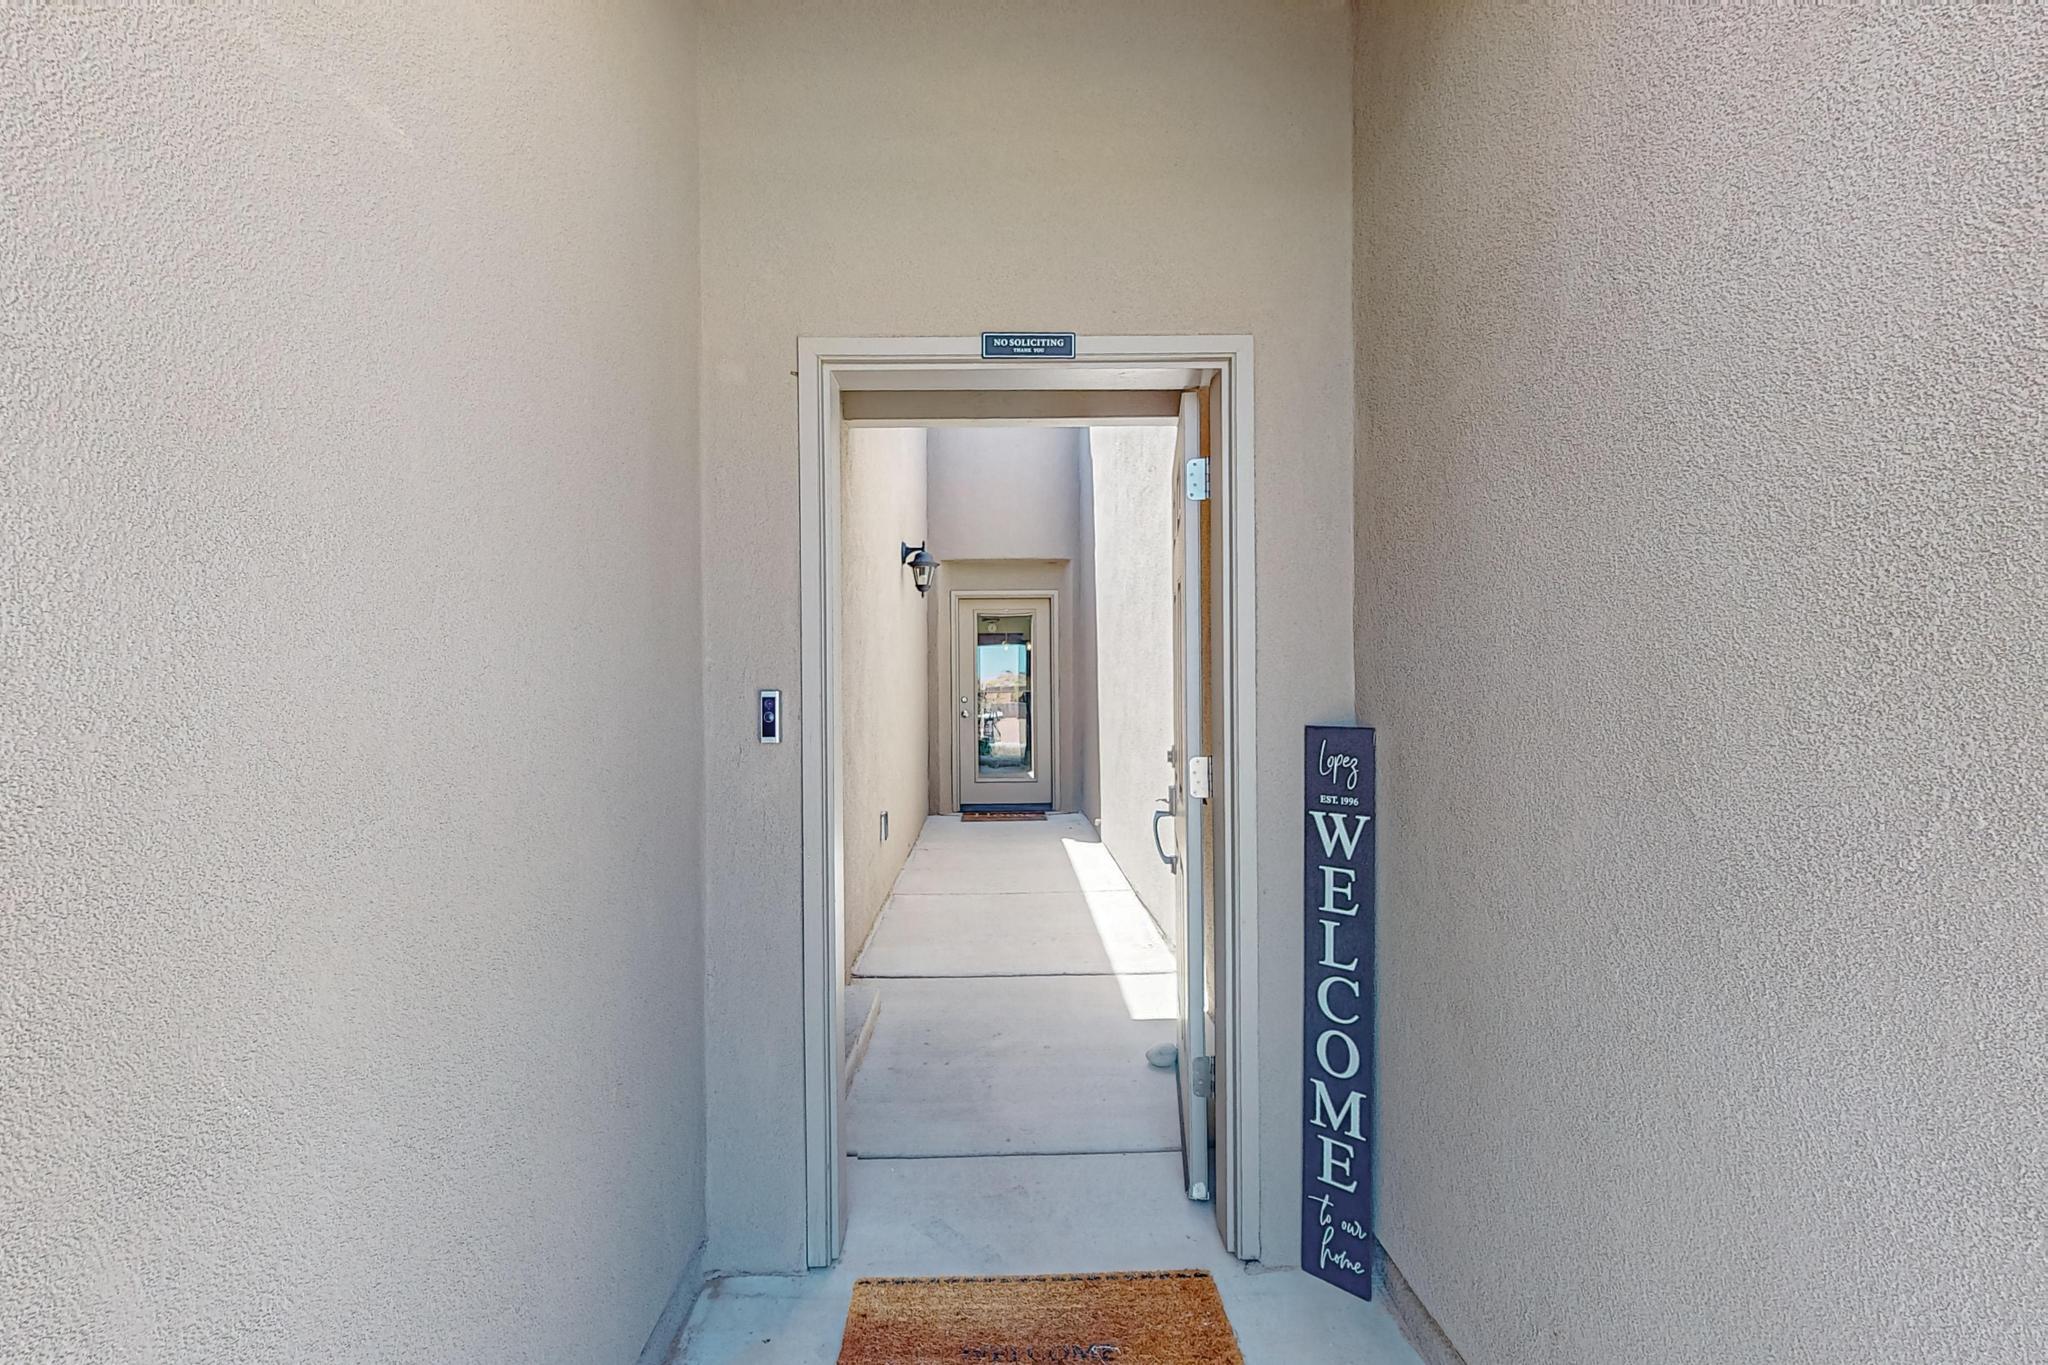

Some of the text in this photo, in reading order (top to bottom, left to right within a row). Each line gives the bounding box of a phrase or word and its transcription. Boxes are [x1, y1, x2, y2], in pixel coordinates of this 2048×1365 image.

[993, 338, 1064, 347] NO SOLICITING
[1319, 739, 1359, 790] Lopez
[1320, 794, 1359, 807] EST. 1996
[1308, 811, 1371, 1193] WELCOME
[1307, 1193, 1367, 1240] to our
[1320, 1225, 1365, 1275] home
